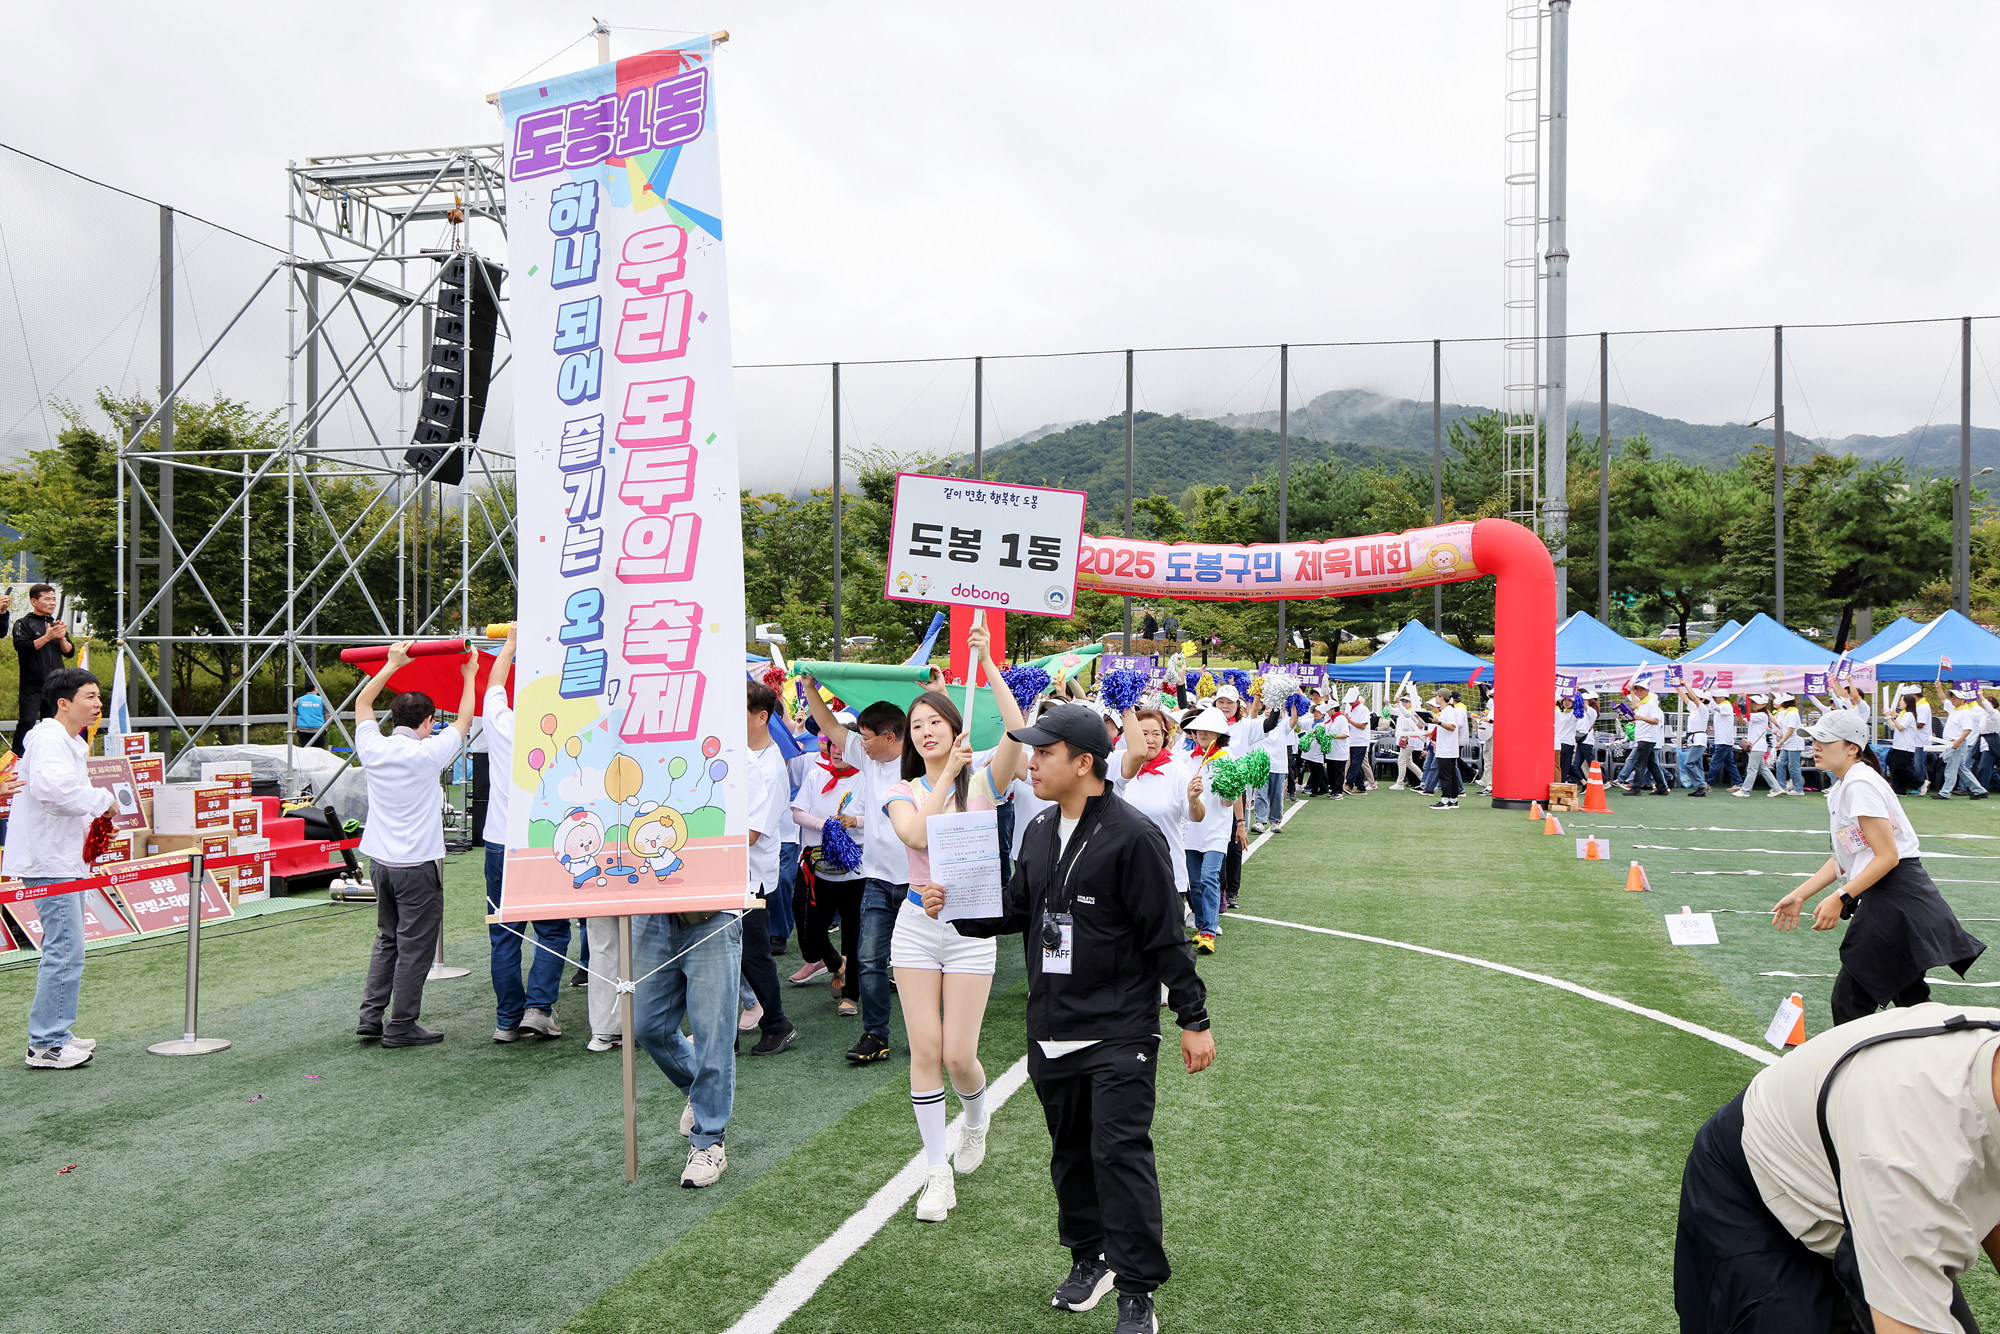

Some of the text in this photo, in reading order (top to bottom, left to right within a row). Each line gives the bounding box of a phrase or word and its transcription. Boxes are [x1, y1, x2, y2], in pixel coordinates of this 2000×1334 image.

[511, 67, 708, 182] 도봉1동
[549, 179, 620, 706] 하나 되어 즐기는 오늘,
[614, 225, 707, 744] 우리 모두의 축제
[943, 487, 962, 500] 같이
[990, 491, 1020, 507] 행복한
[1023, 495, 1038, 510] 도봉
[908, 522, 1062, 572] 도봉 1동
[1078, 539, 1412, 584] 2025 도봉구민 체육대회
[951, 583, 1010, 605] dobong
[1114, 658, 1136, 670] 최강
[1300, 666, 1315, 675] 최강
[136, 772, 149, 780] 쿠쿠
[208, 800, 220, 809] 쿠쿠
[241, 869, 253, 877] 쿠쿠
[149, 878, 177, 894] 삼성
[132, 891, 206, 914] 무빙스타일
[1045, 949, 1070, 959] STAFF
